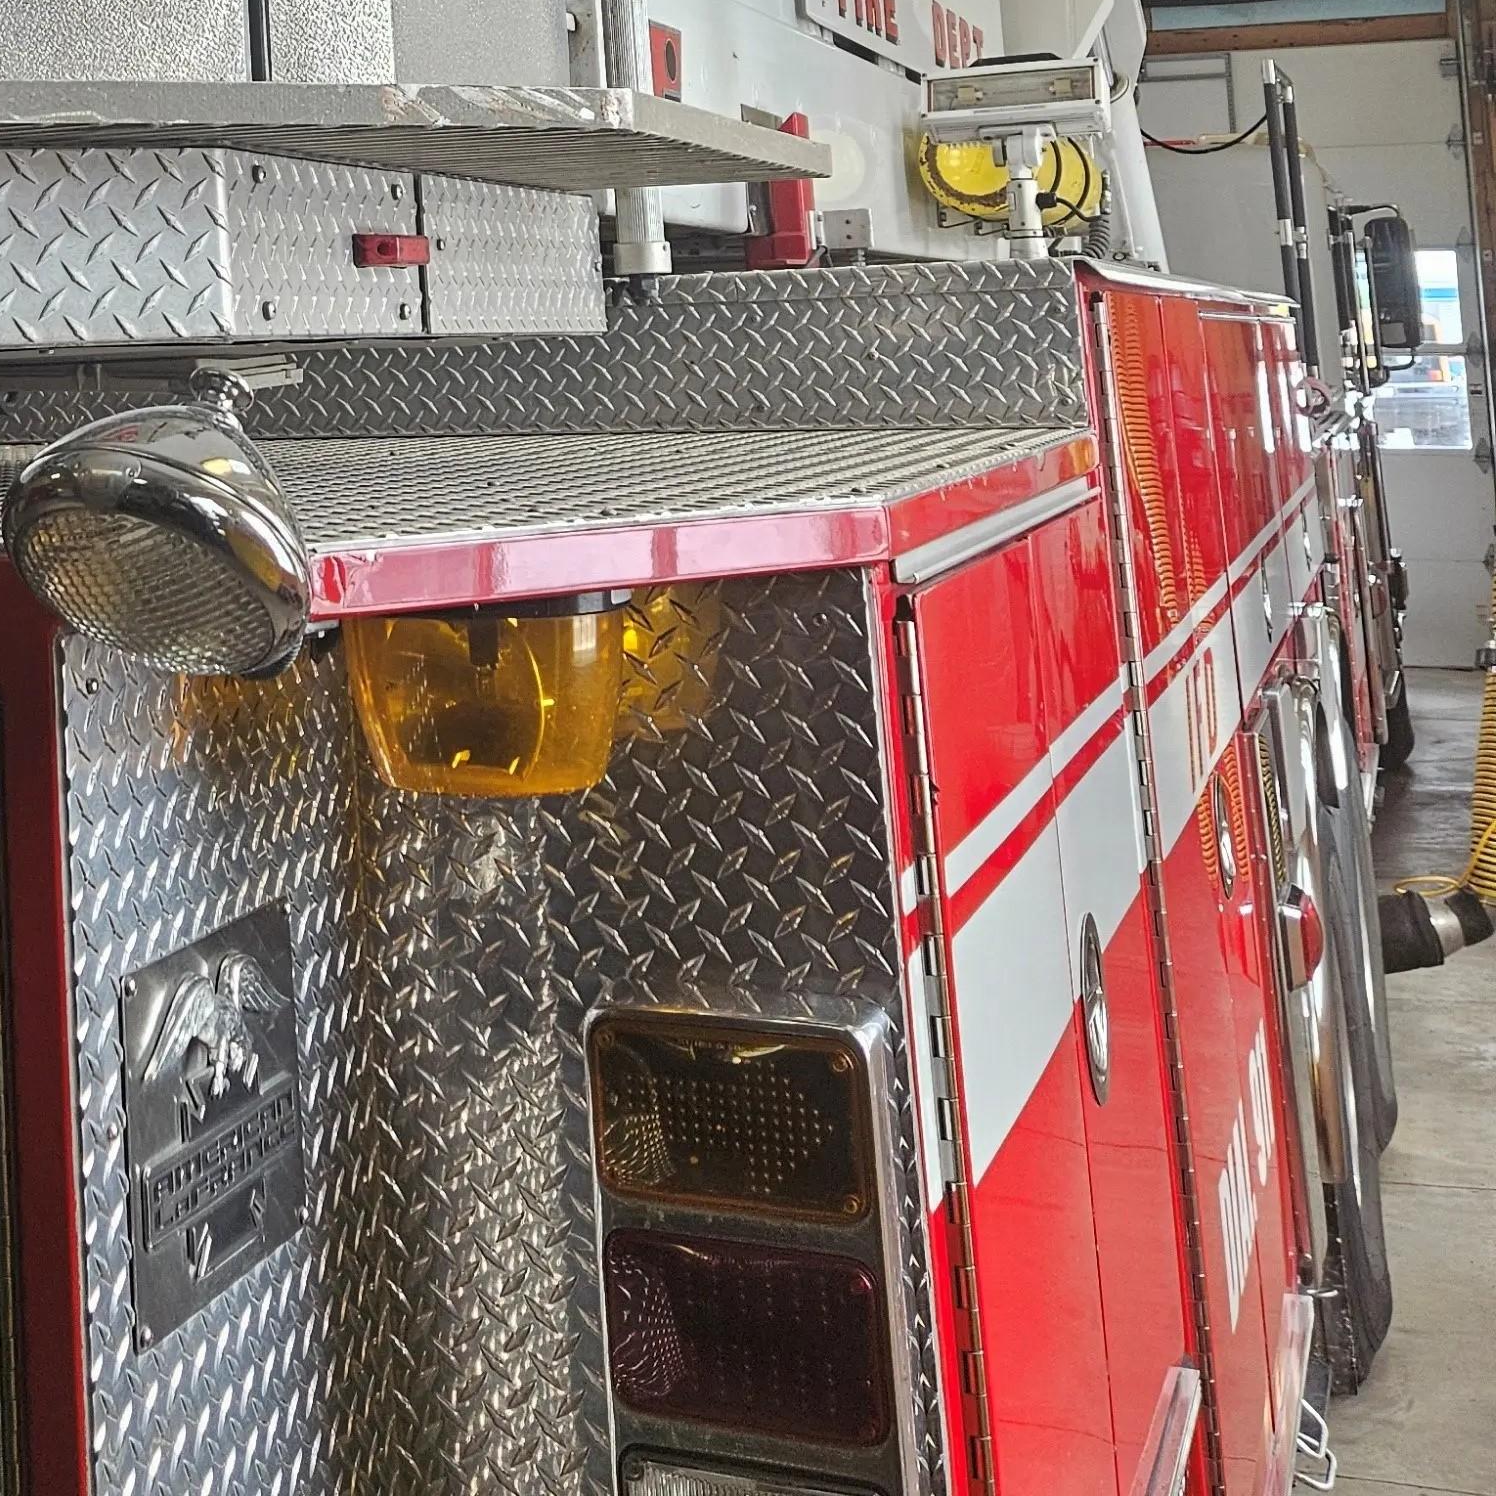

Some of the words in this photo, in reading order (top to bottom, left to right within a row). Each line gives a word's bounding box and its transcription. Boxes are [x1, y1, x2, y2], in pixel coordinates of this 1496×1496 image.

[931, 0, 985, 70] DEPT
[154, 1087, 296, 1205] AMERICAN
[1218, 1097, 1259, 1335] DIAL
[1248, 1017, 1276, 1187] 911
